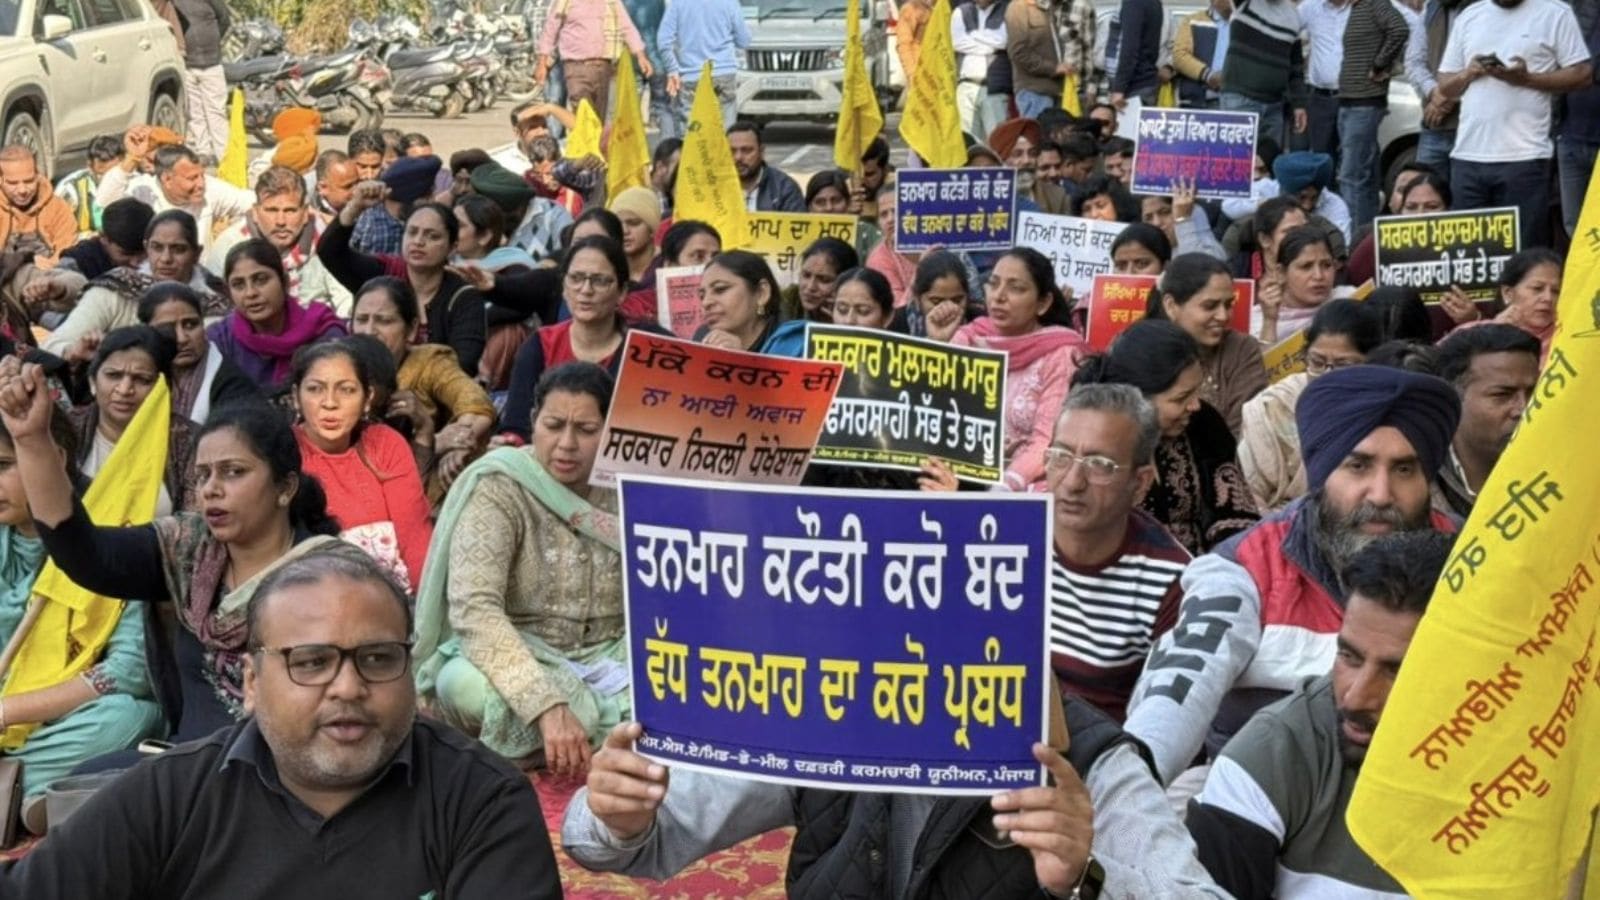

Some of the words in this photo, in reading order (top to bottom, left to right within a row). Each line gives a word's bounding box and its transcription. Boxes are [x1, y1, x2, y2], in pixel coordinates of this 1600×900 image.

[900, 182, 937, 202] ਤਨਖਾਹ
[940, 173, 969, 201] ਕਟੌਤੀ
[972, 172, 990, 200] ਕਰੋ
[992, 171, 1010, 199] ਬੰਦ
[789, 220, 811, 240] ਦਾ
[818, 220, 854, 241] ਮਾਨ
[902, 208, 918, 234] ਵੱਧ
[921, 215, 953, 234] ਤਨਖਾਹ
[955, 214, 967, 234] ਦਾ
[968, 205, 985, 232] ਕਰੋ
[987, 204, 1009, 236] ਪ੍ਰਬੰਧ
[1060, 222, 1087, 248] ਲਈ
[1379, 220, 1428, 249] ਸਰਕਾਰ
[1487, 214, 1513, 248] ਮਾਰੂ
[777, 246, 797, 271] ਦੀ
[1061, 252, 1072, 277] ਹੋ
[1452, 249, 1474, 283] ਸੱਭ
[1475, 248, 1487, 282] ਤੇ
[1489, 255, 1513, 281] ਭਾ
[630, 343, 692, 375] ਪੱਕੇ
[706, 359, 789, 389] ਕਰਨ
[801, 367, 839, 392] ਦੀ
[812, 334, 883, 378] ਸਰਕਾਰ
[886, 341, 958, 391] ਮੁਲਾਜ਼ਮ
[962, 356, 1000, 410] ਮਾਰੂ
[641, 386, 671, 407] ਨਾ
[680, 393, 738, 420] ਆਈ
[745, 403, 806, 425] ਅਵਾਜ
[824, 389, 911, 440] ਫਸਰਸ਼ਾਹੀ
[914, 391, 943, 444] ਸੱਭ
[946, 397, 961, 449] ਤੇ
[963, 415, 997, 466] ਭਾਰੂ
[603, 427, 679, 468] ਸਰਕਾਰ
[680, 427, 747, 477] ਨਿਕਲੀ
[633, 522, 749, 598] ਤਨਖਾਹ
[761, 505, 868, 608] ਕਟੌਤੀ
[883, 509, 948, 611] ਕਰੋ
[964, 513, 1030, 611] ਬੰਦ
[645, 616, 689, 703] ਵੱਧ
[699, 645, 807, 719] ਤਨਖਾਹ
[819, 657, 860, 722] ਦਾ
[873, 632, 930, 726] ਕਰੋ
[943, 636, 1027, 751] ਪ੍ਰਬੰਧ
[851, 763, 921, 780] ਕਰਮਚਾਰੀ
